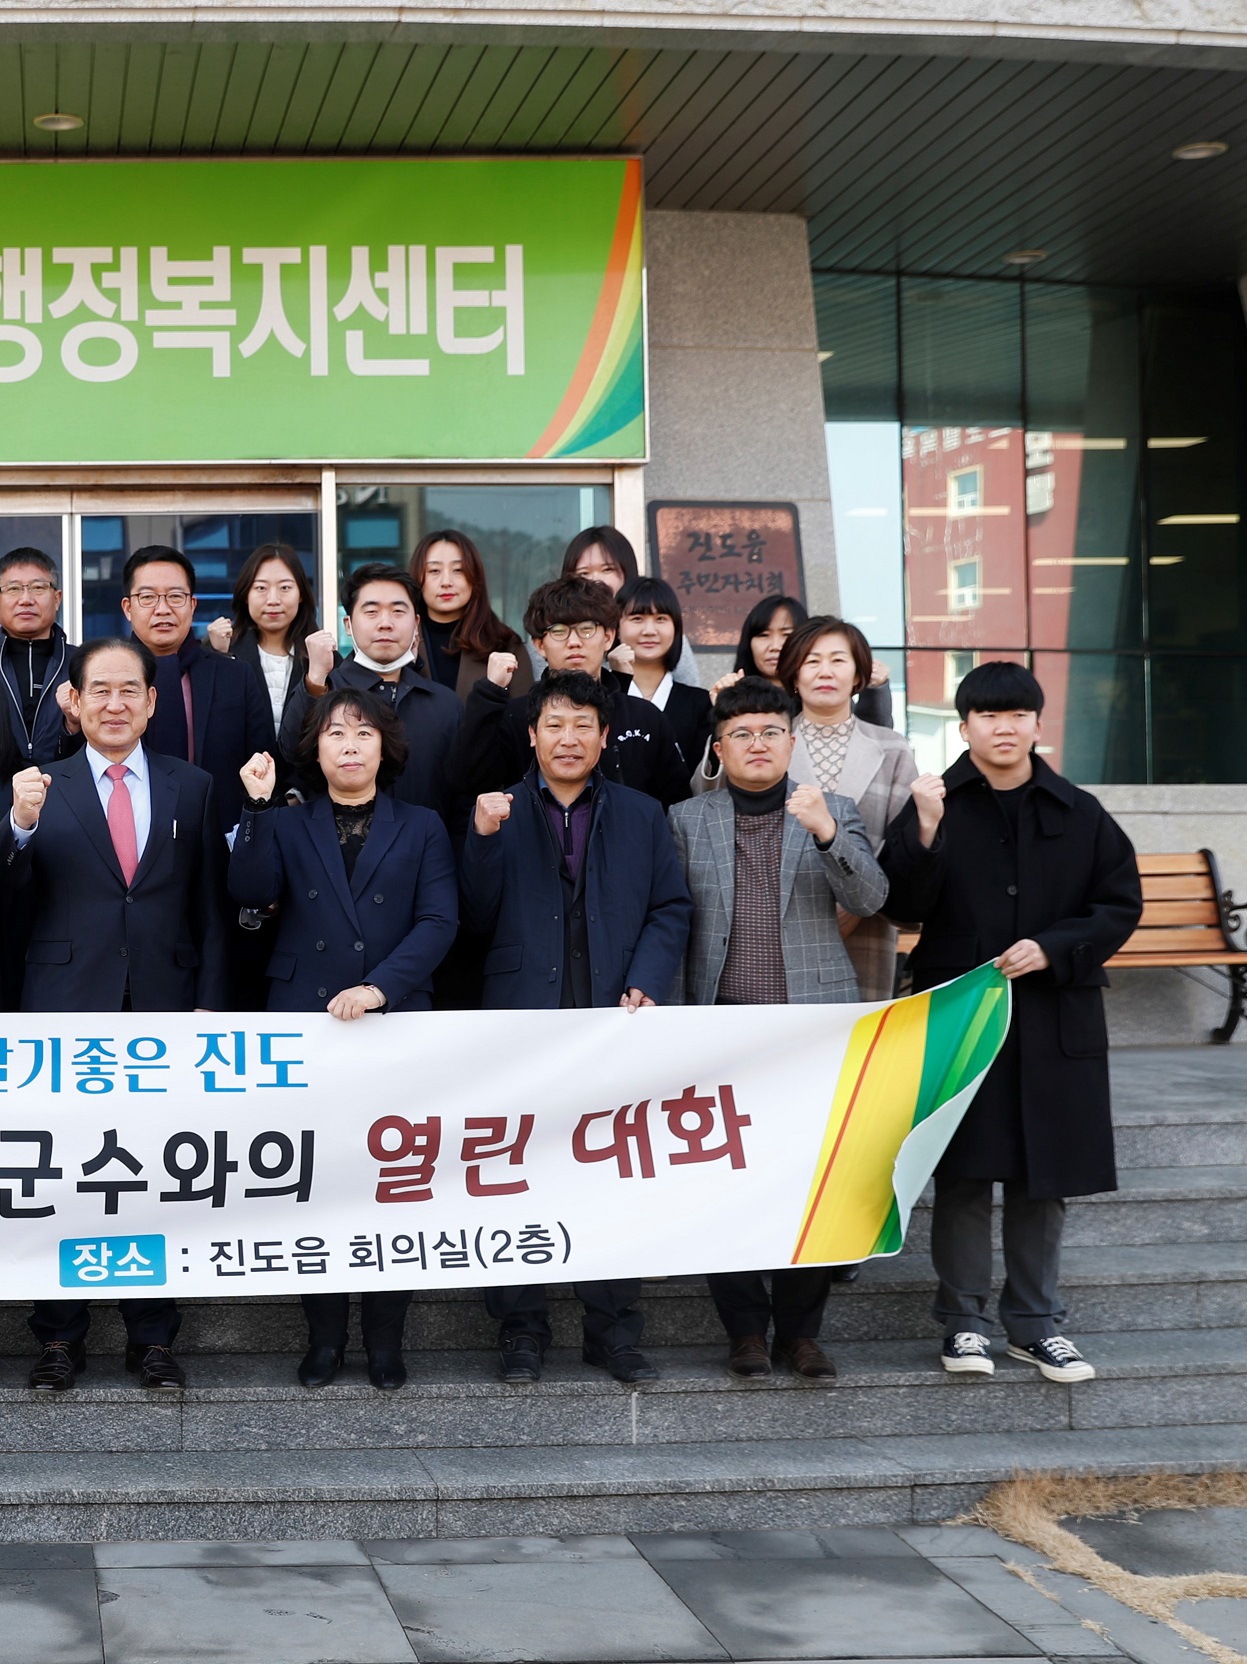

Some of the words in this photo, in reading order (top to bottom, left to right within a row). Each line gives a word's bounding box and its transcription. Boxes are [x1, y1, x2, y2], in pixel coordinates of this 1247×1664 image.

[686, 529, 767, 564] 진도읍
[677, 570, 785, 595] 주민자치회
[194, 1031, 309, 1093] 진도
[367, 1114, 535, 1204] 열린
[572, 1084, 752, 1179] 대화
[72, 1242, 155, 1281] 장소
[209, 1236, 331, 1277] 진도읍
[348, 1221, 573, 1273] 회의실(2층)
